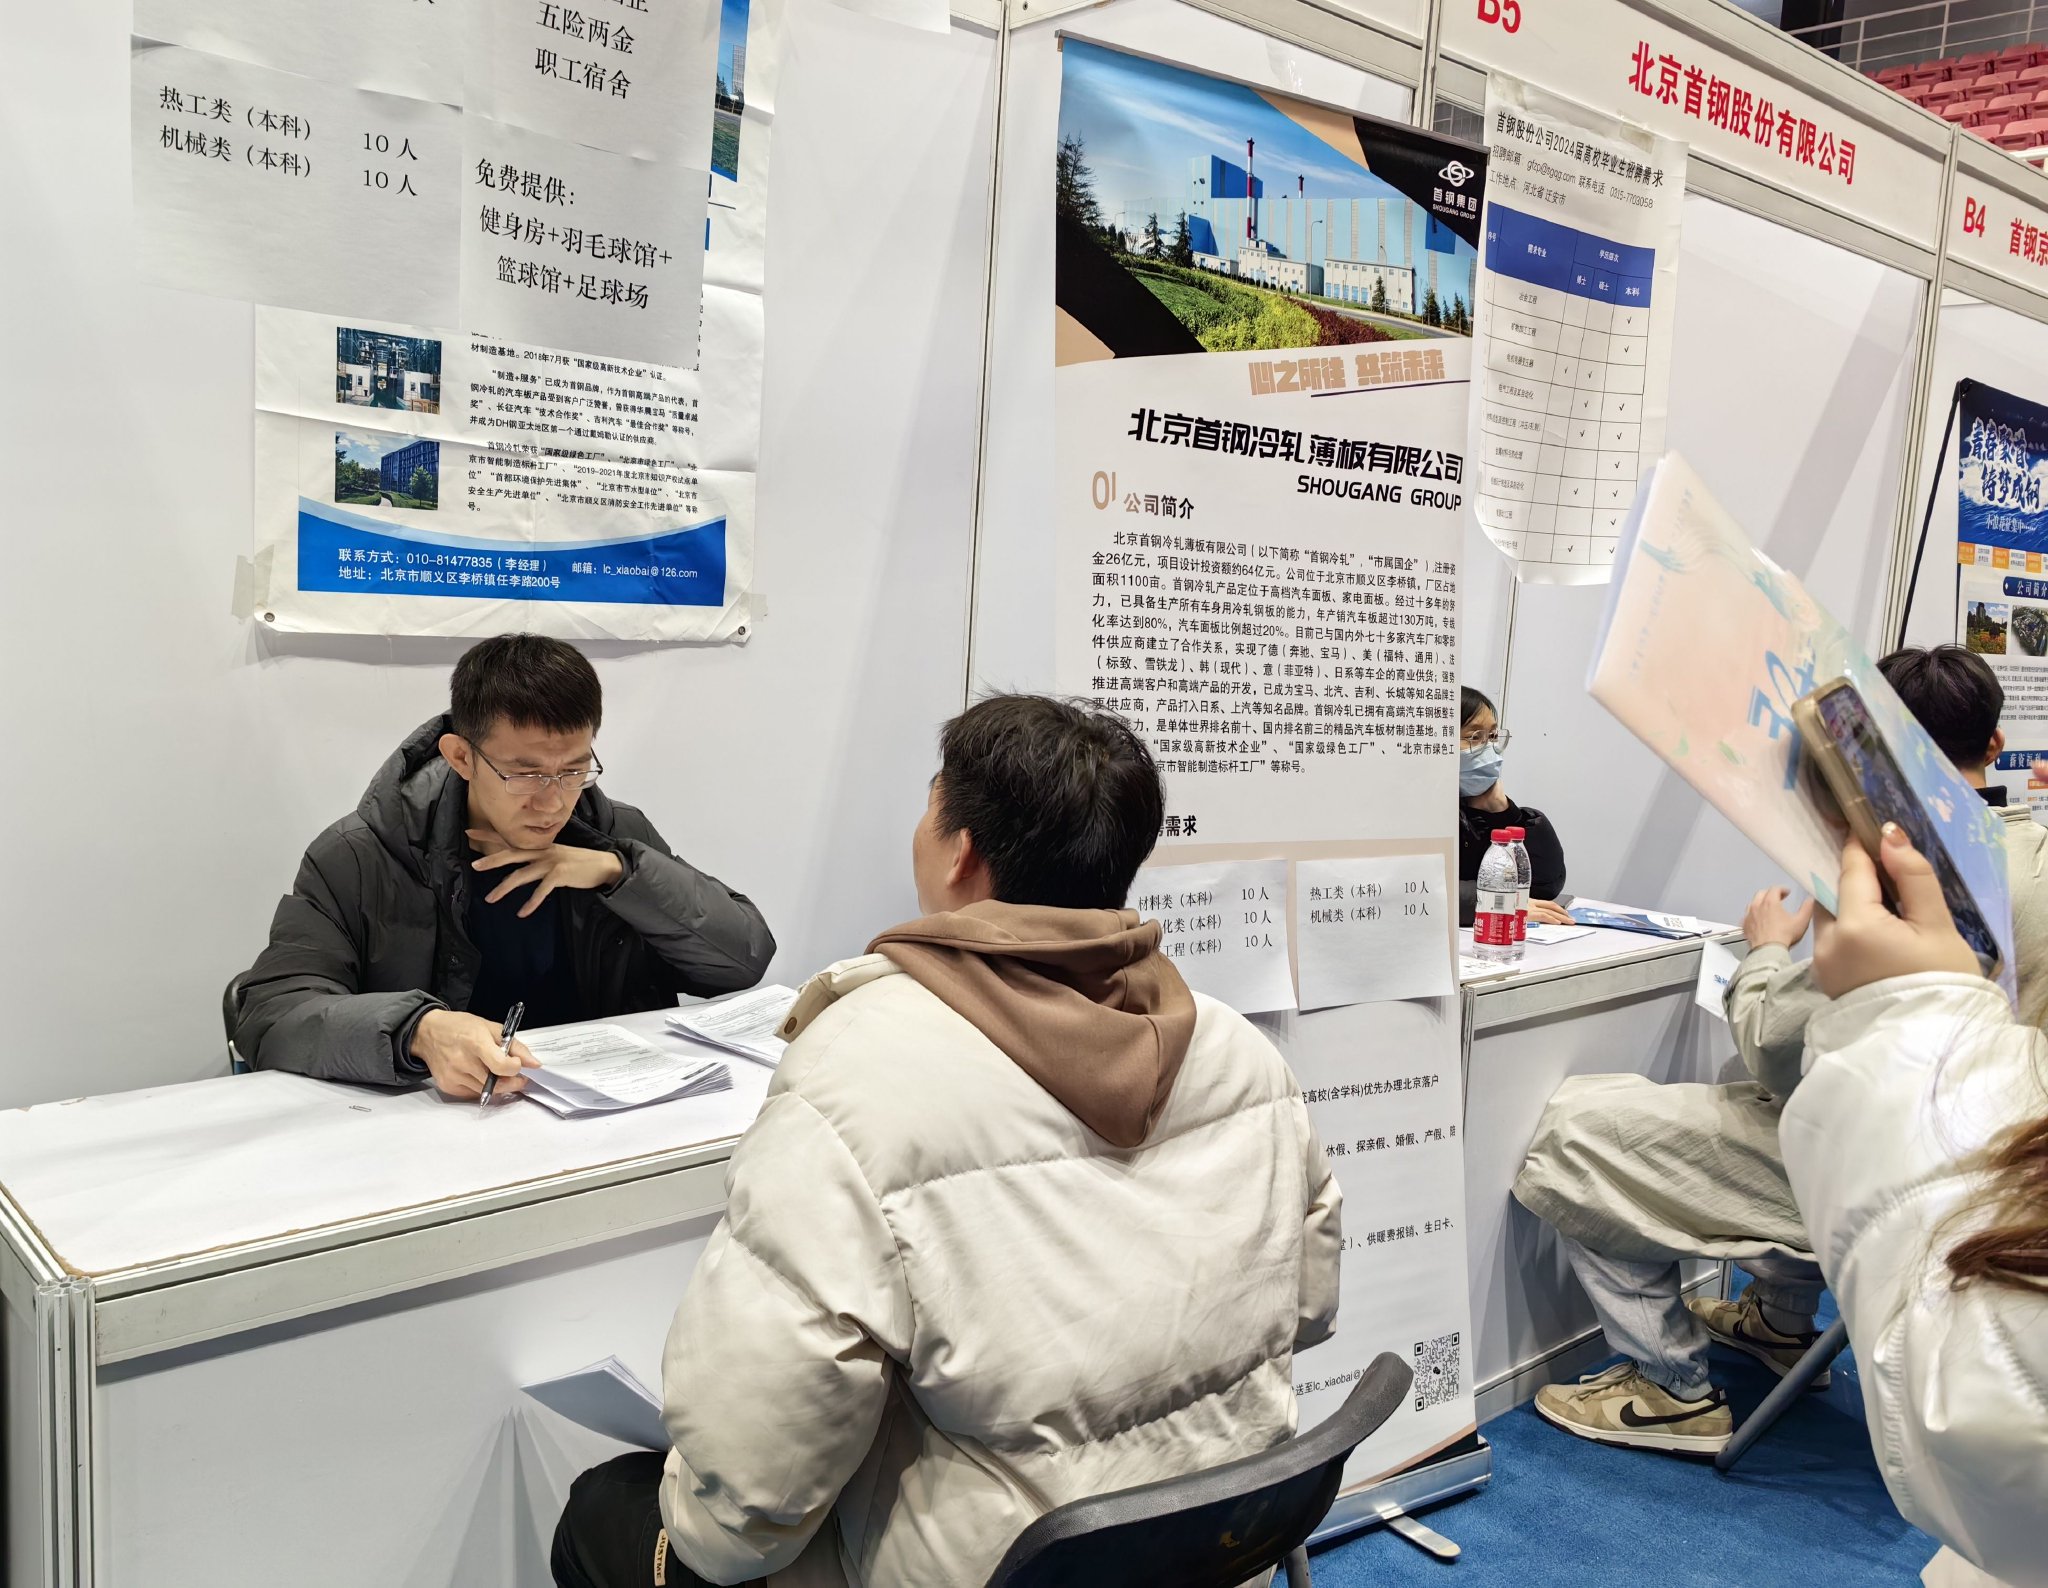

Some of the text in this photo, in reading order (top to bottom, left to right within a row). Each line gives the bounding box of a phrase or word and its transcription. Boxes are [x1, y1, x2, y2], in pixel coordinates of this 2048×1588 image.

[536, 1, 635, 54] 五险两金
[1478, 0, 1521, 33] B5
[535, 47, 631, 98] 职工宿舍
[1628, 40, 1857, 186] 北京首钢股份有限公司
[1497, 111, 1664, 188] 首钢股份公司2024届高校毕业生招聘需求
[474, 157, 575, 205] 免费提供：
[1433, 187, 1477, 212] 首钢集团
[1432, 204, 1475, 219] SHOUGANG GROUP
[1963, 196, 1986, 238] B4
[479, 205, 673, 269] 健身房+羽毛球馆+
[496, 254, 649, 310] 篮球馆+足球场
[1625, 287, 1639, 297] 本科
[1249, 350, 1446, 395] 心之所往 共筑未来
[1128, 407, 1464, 484] 北京首钢冷轧薄板有限公司
[1092, 471, 1116, 510] 01
[1124, 492, 1194, 519] 公司简介
[1297, 475, 1462, 511] SHOUGANG GROUP
[338, 567, 561, 589] 地址：北京市顺义区李桥镇任李路200号
[2017, 581, 2048, 598] 公司简介
[1159, 816, 1197, 836] 需求
[1162, 914, 1221, 935] 化类（本科）
[1162, 939, 1221, 959] 工程（本科）
